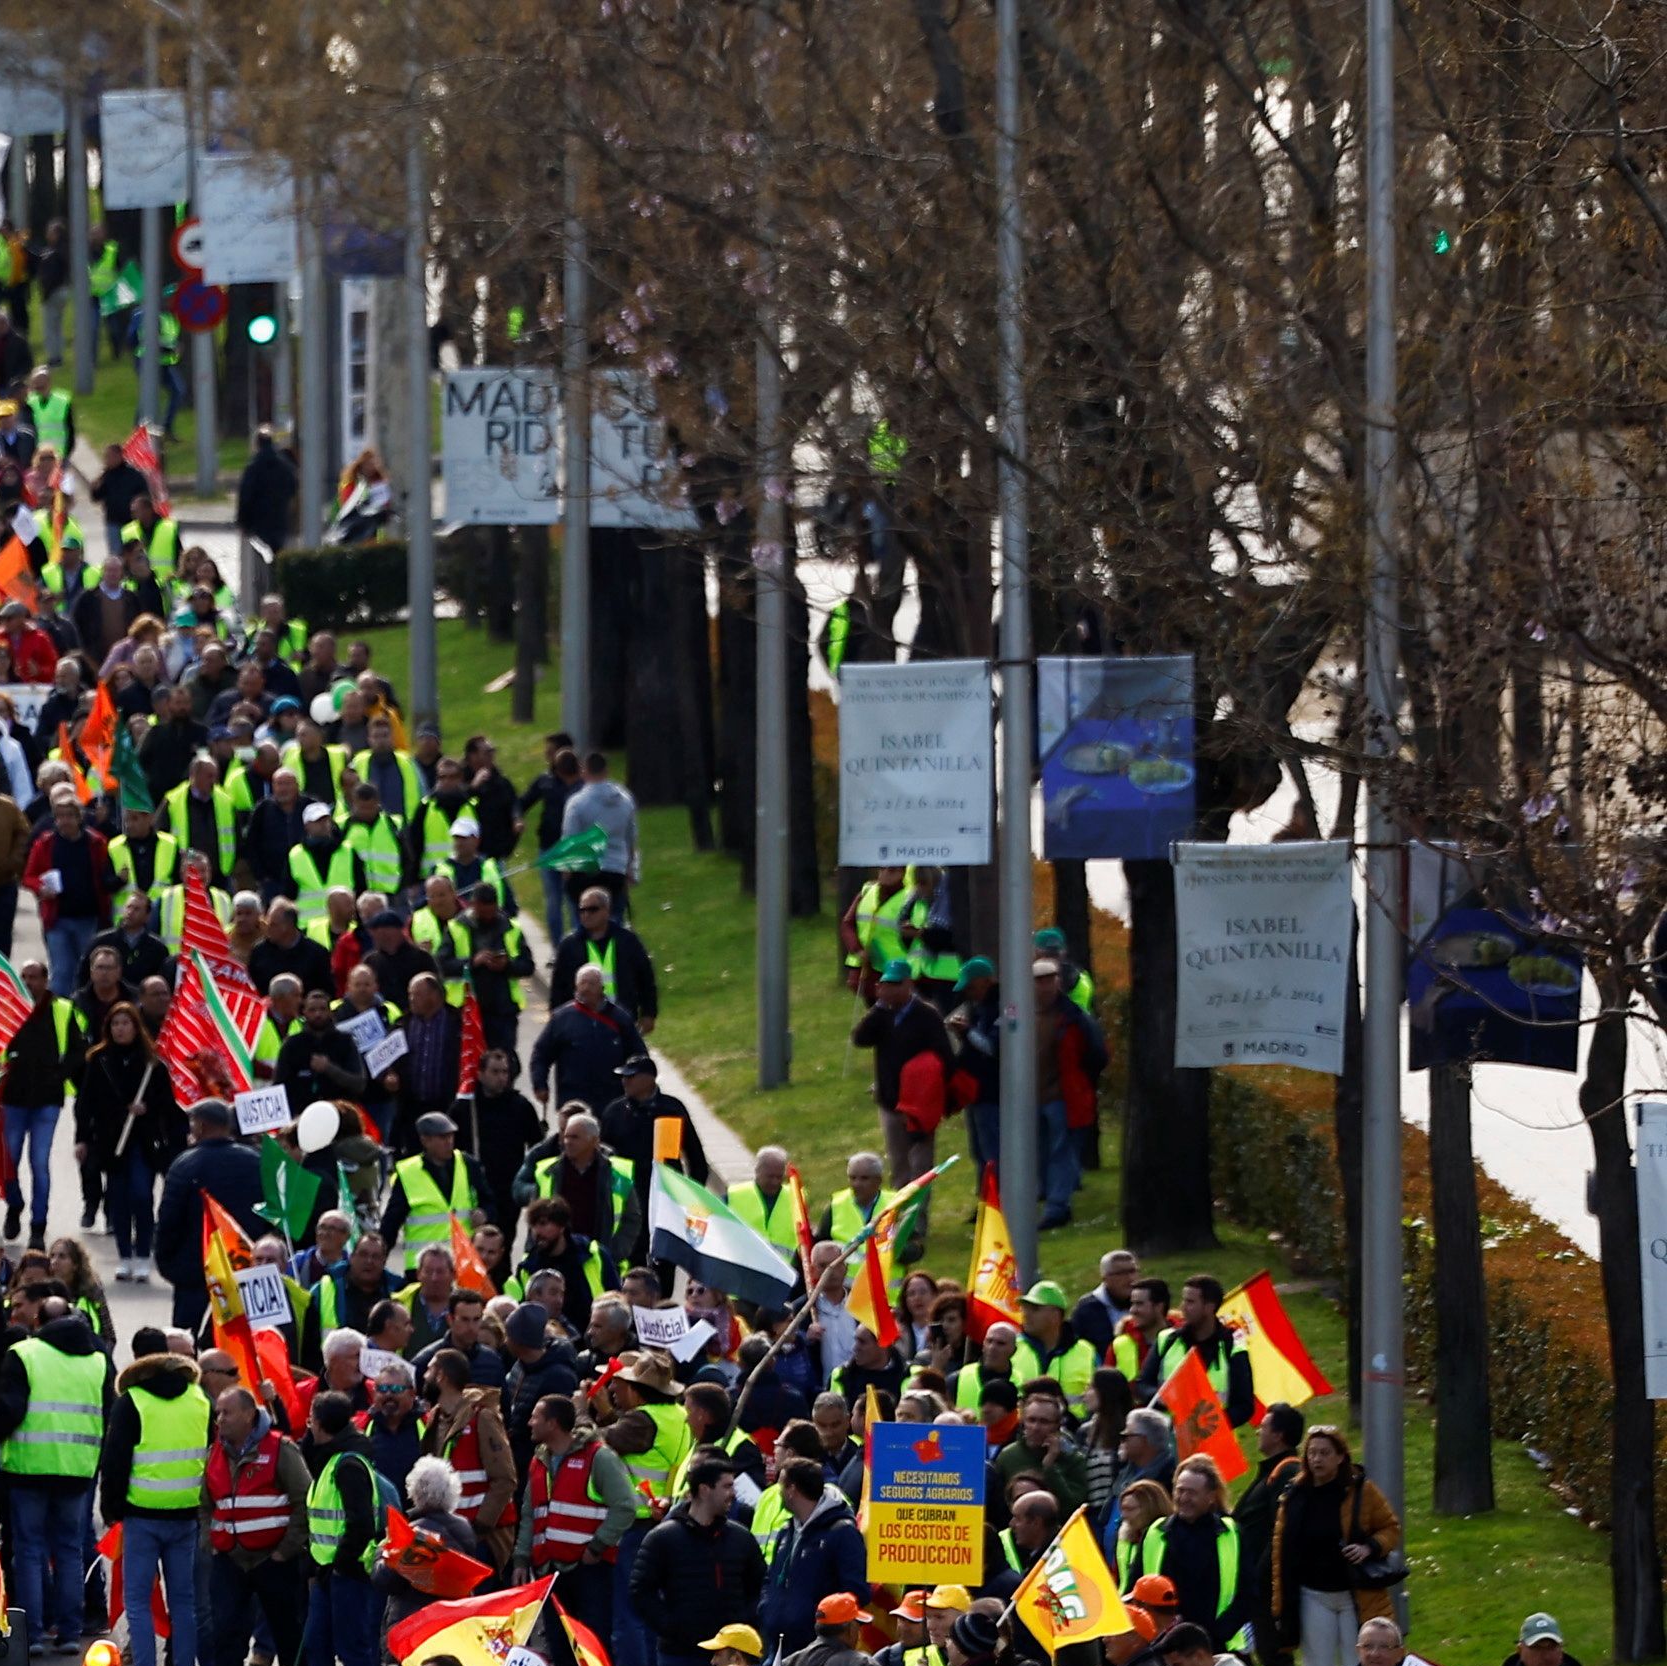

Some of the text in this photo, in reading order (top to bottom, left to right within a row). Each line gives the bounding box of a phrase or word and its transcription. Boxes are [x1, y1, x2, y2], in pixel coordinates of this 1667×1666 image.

[487, 421, 552, 456] RID
[881, 734, 946, 750] ISABEL
[845, 756, 982, 775] QUINTANILLA
[896, 846, 950, 858] MADRID
[1226, 917, 1302, 936] ISABEL
[1185, 942, 1341, 970] QUINTANILLA
[1243, 1041, 1307, 1058] MADRID
[237, 1275, 284, 1316] TICIA!
[893, 1471, 961, 1485] NECESITAMOS
[880, 1486, 974, 1501] SEGUROS AGRARIOS
[896, 1508, 956, 1521] QUE CUBRAN
[879, 1524, 970, 1541] LOS COSTOS DE
[878, 1543, 972, 1565] PRODUCCIÓN
